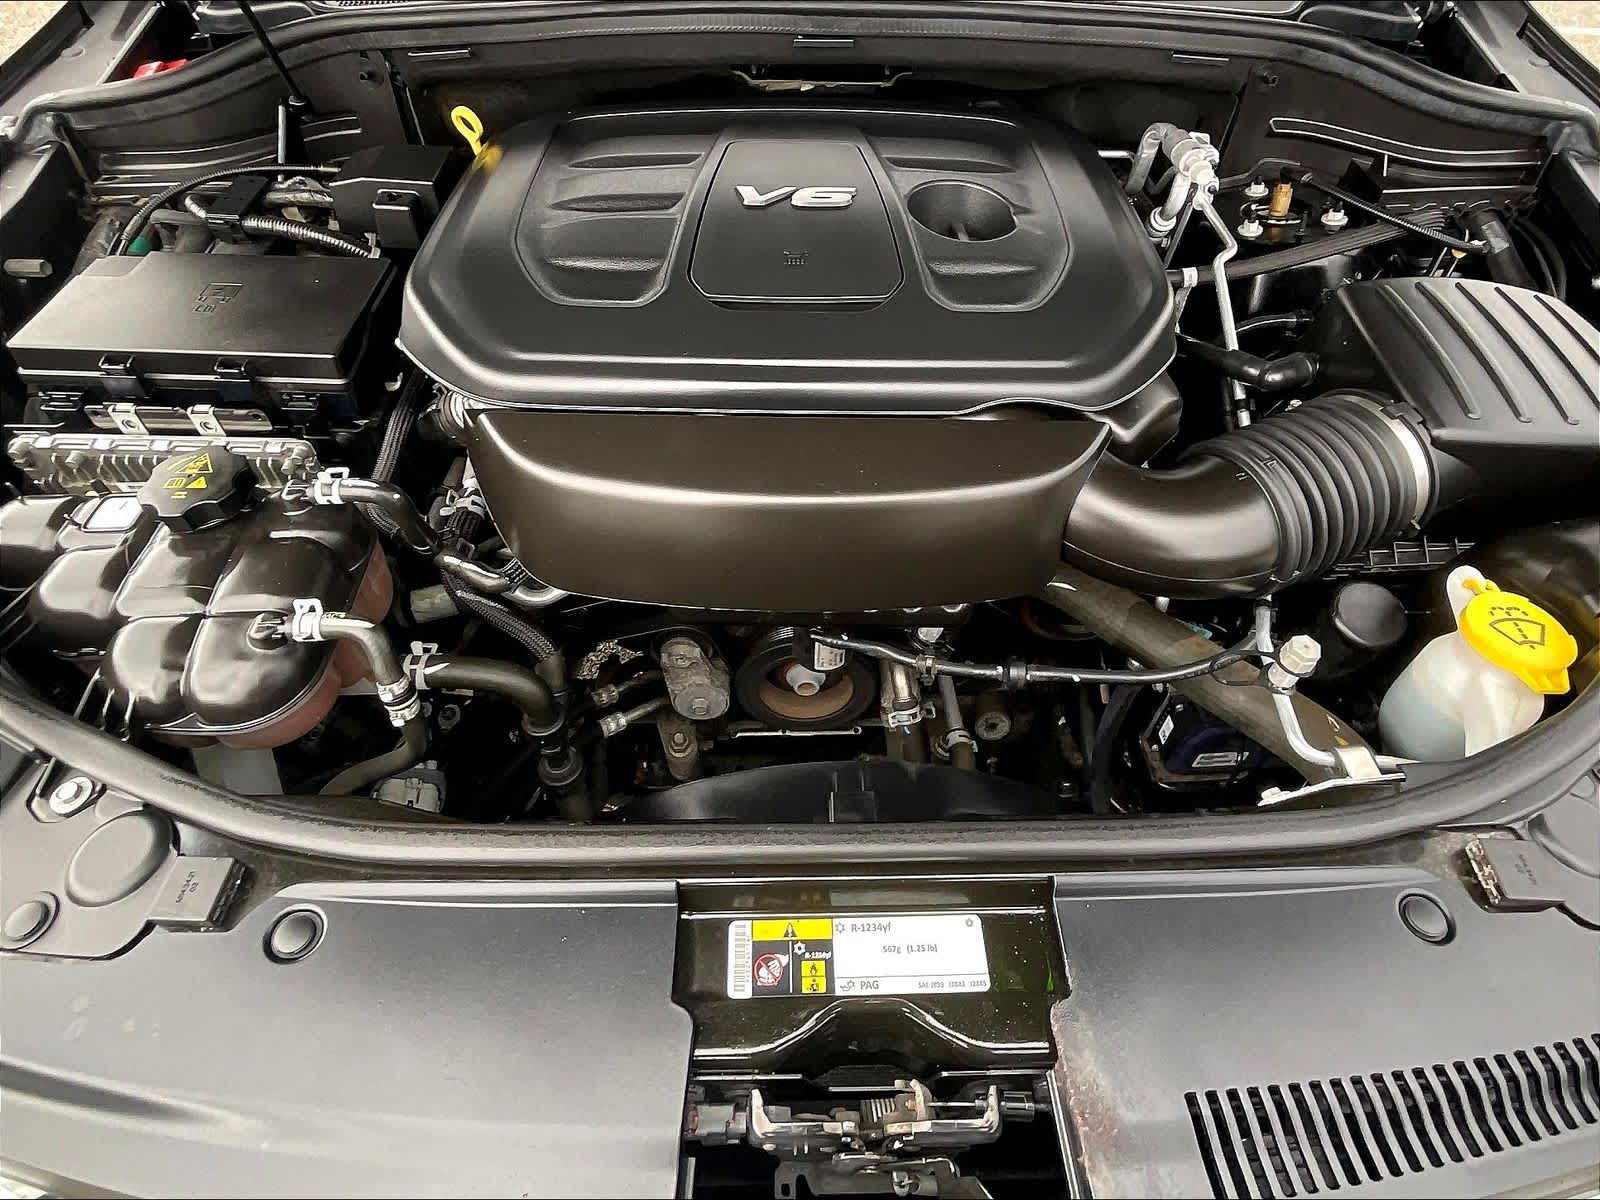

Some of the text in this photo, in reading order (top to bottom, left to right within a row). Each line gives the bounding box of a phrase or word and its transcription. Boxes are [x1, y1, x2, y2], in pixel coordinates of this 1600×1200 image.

[735, 184, 857, 210] V6
[850, 922, 892, 934] R-1234yf
[860, 980, 880, 991] PAG
